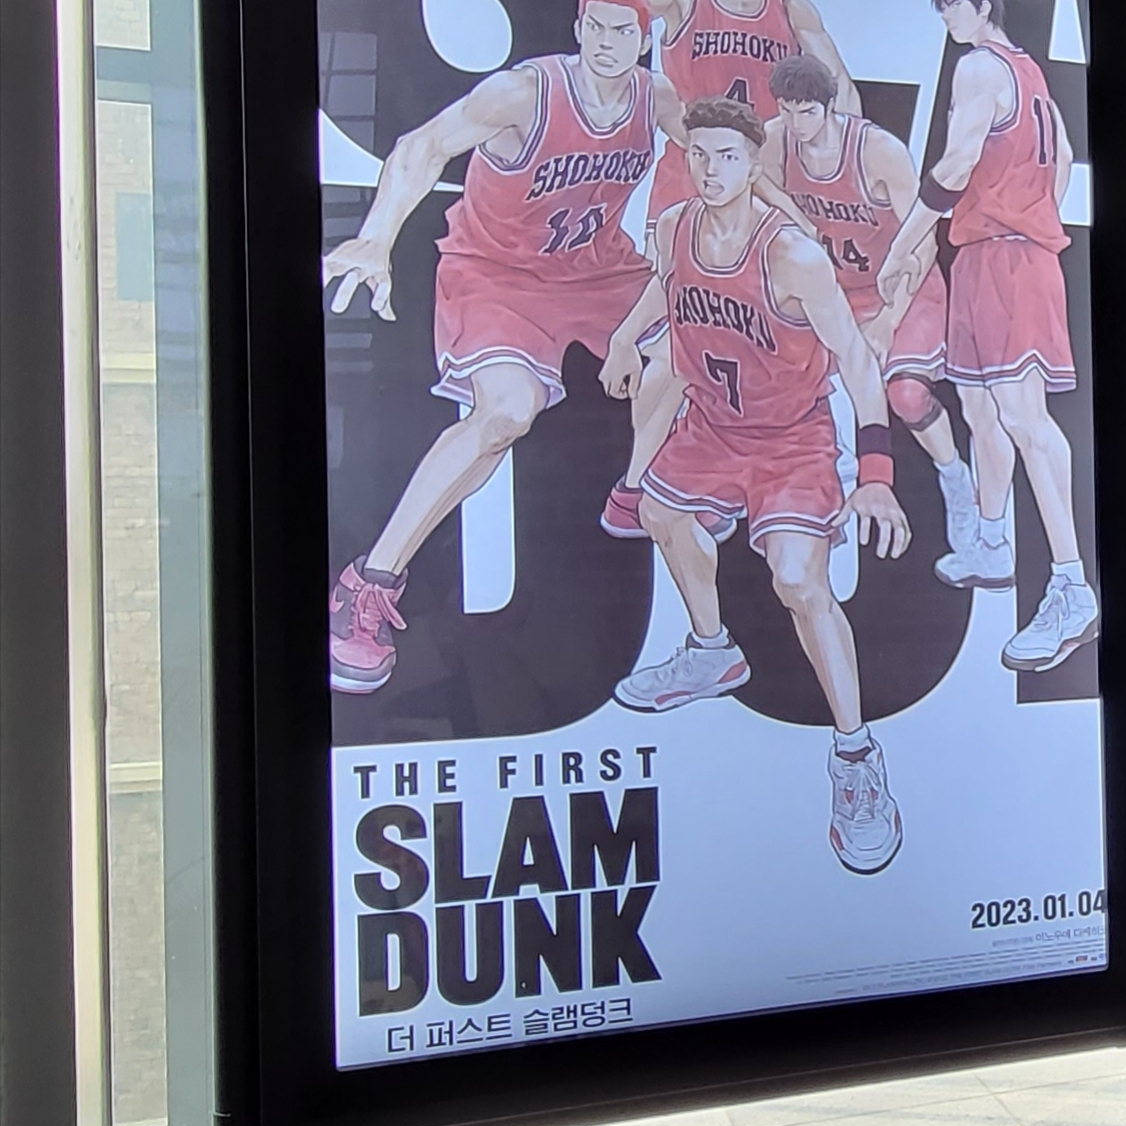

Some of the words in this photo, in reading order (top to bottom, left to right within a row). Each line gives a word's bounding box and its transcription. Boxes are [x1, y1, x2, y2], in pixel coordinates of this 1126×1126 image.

[691, 30, 788, 62] SHOHOKU
[525, 149, 651, 201] SHOHOKU
[790, 193, 879, 227] HOHOKU
[821, 234, 870, 272] 14
[703, 351, 743, 415] 7
[353, 759, 457, 799] THE
[498, 746, 658, 789] FIRST
[353, 786, 661, 911] SLAM
[971, 888, 1105, 929] 2023.01.04
[357, 885, 663, 1017] DUNK
[387, 1024, 415, 1053] 더
[425, 1013, 513, 1048] 퍼스트
[522, 997, 634, 1036] 슬램덩크
